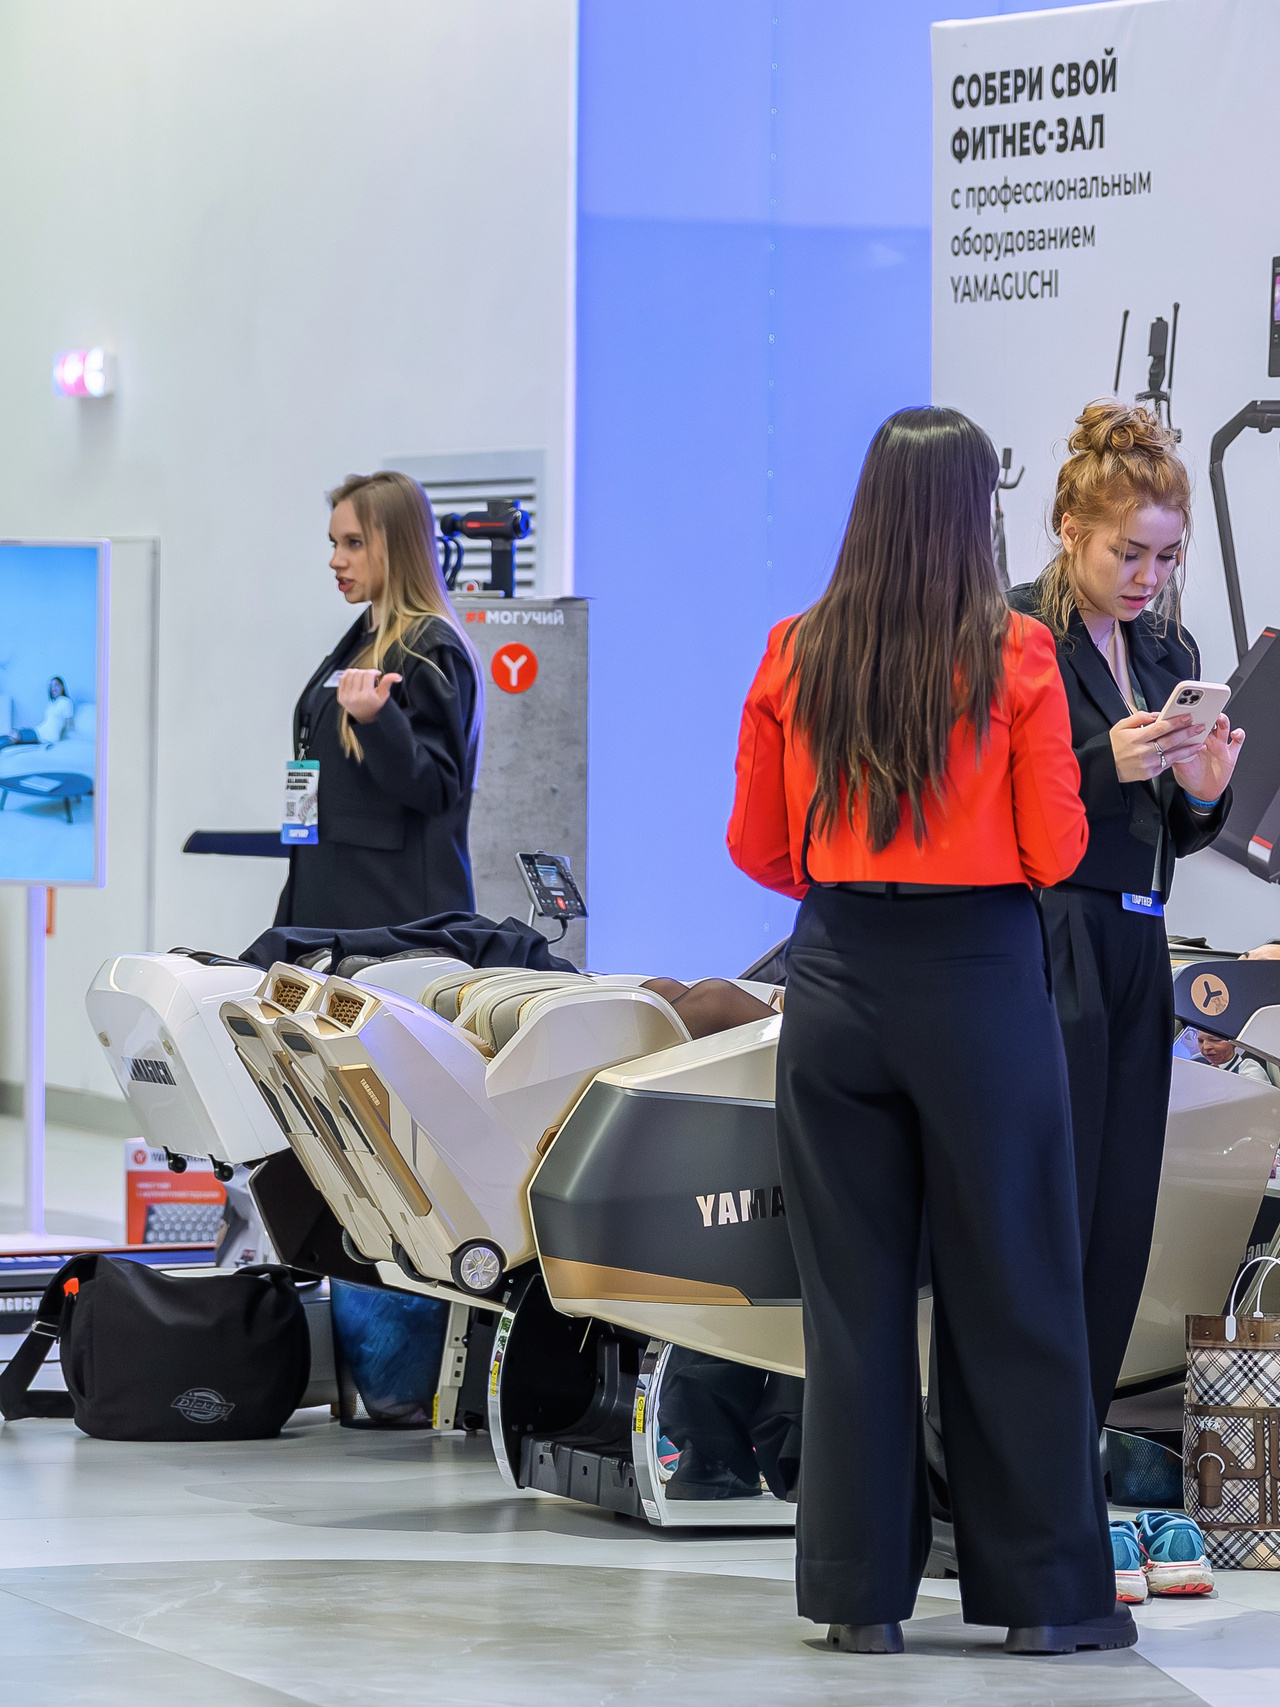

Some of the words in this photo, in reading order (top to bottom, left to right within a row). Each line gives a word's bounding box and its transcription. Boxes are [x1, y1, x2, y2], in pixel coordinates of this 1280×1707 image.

[952, 66, 1043, 109] СОБЕРИ
[1051, 47, 1117, 99] СВОЙ
[952, 113, 1105, 164] ФИТНЕС-ЗАЛ
[951, 187, 961, 209] с
[965, 171, 1152, 216] профессиональным
[951, 225, 1096, 262] оборудованием
[950, 269, 1059, 304] YAMAGUCHI
